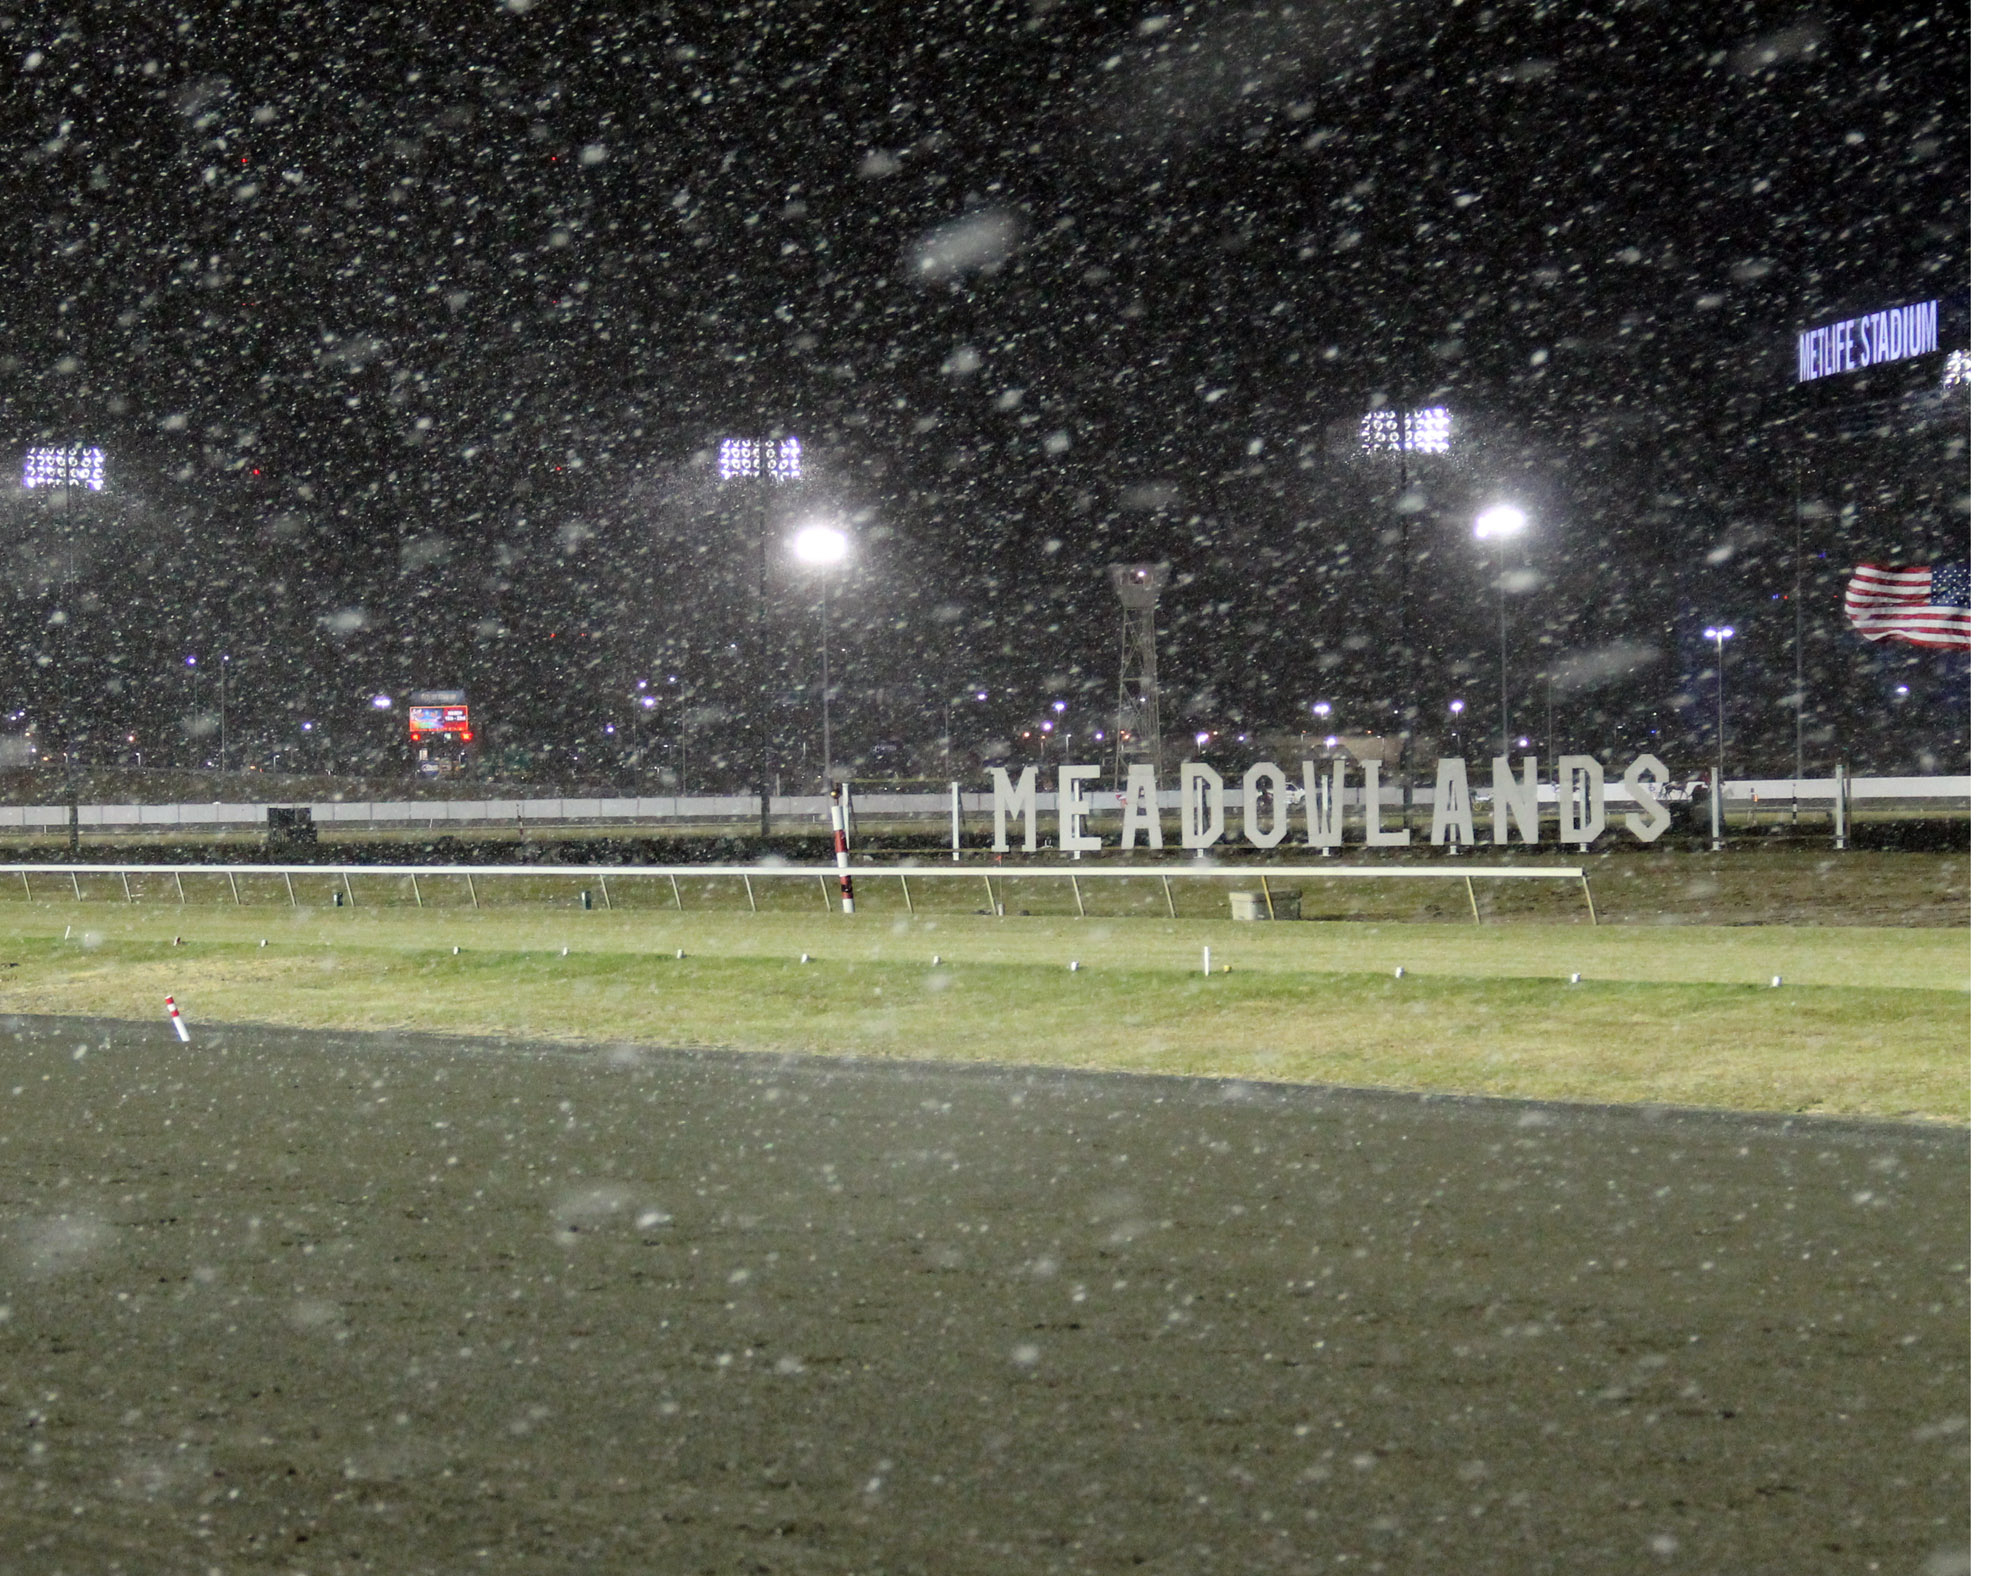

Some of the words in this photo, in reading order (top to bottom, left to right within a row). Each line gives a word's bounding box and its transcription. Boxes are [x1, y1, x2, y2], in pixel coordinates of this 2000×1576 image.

[1799, 319, 1856, 383] METLIFE
[1860, 299, 1938, 367] STADIUM
[990, 753, 1671, 852] MEADOWLANDS
